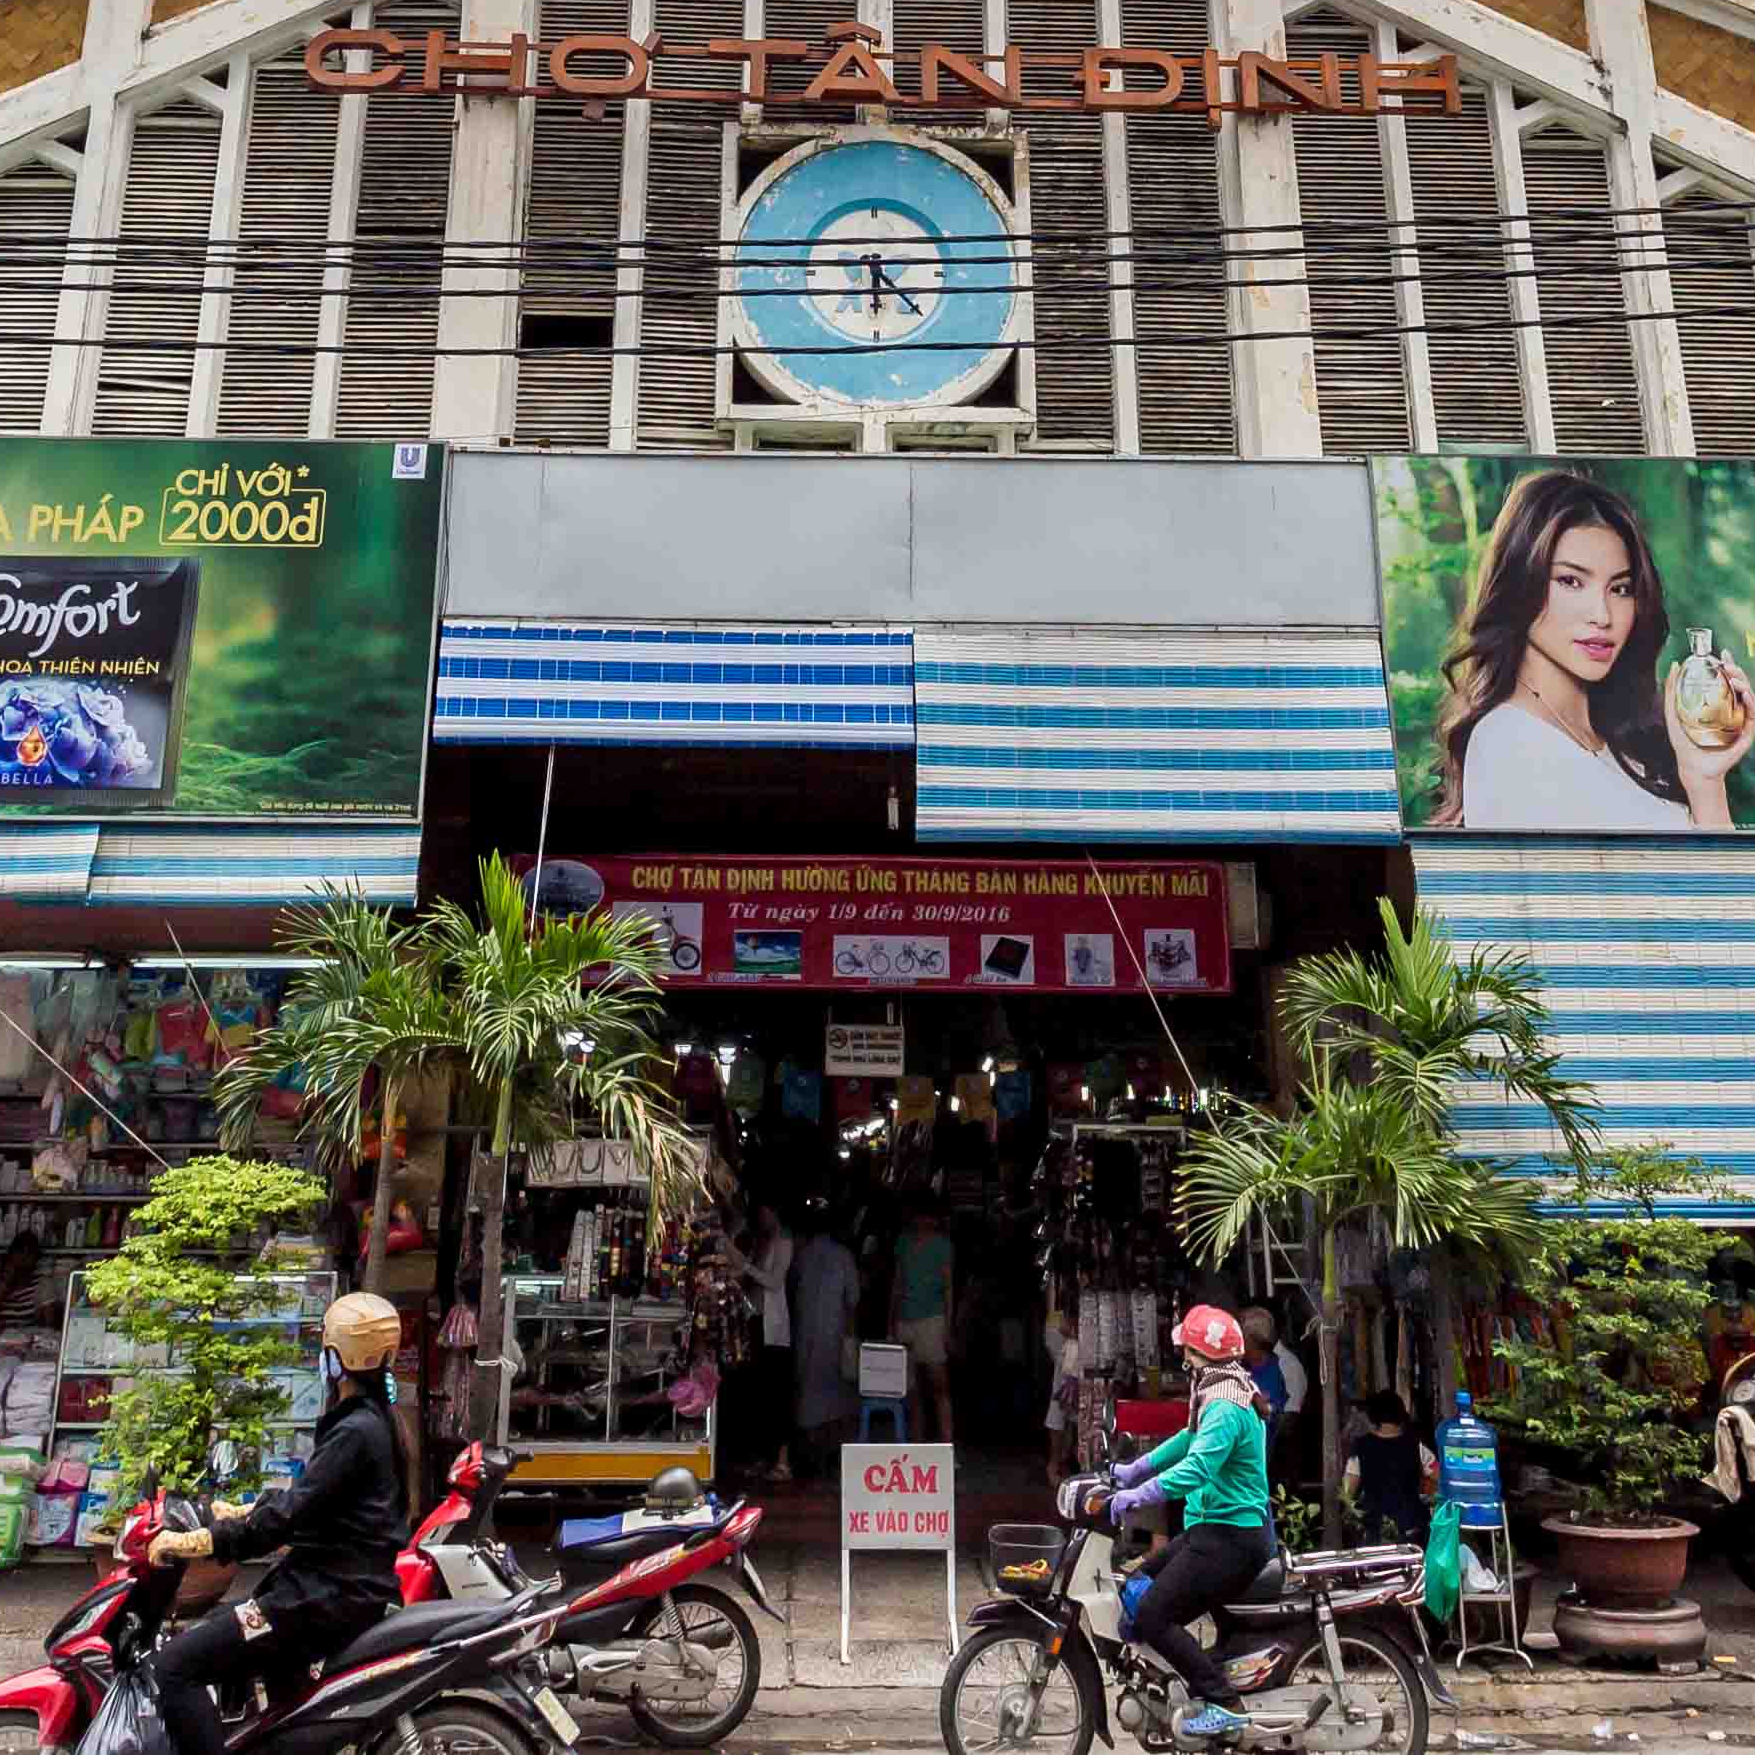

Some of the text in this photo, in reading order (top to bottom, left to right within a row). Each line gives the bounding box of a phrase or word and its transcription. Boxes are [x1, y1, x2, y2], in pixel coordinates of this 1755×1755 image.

[301, 20, 1462, 129] CHỢ TÂN ĐỊNH
[174, 462, 228, 497] CHỈ
[27, 492, 144, 544] PHÁP
[168, 496, 319, 544] 2000đ
[38, 655, 95, 675] THIÊN
[99, 655, 160, 675] NHIÊN
[1, 771, 53, 786] BELLA
[630, 862, 674, 894] CHỢ
[680, 862, 721, 892] TÂN
[726, 867, 775, 895] ĐỊNH
[902, 865, 971, 895] THÁNG
[975, 867, 1017, 895] BÁN
[1023, 866, 1079, 896] HÀNG
[765, 902, 820, 924] ngày
[826, 902, 856, 920] 1/9
[912, 903, 1013, 924] 30/9/2016
[863, 1453, 939, 1495] CẤM
[849, 1506, 950, 1539] XE VÀO CHỢ
